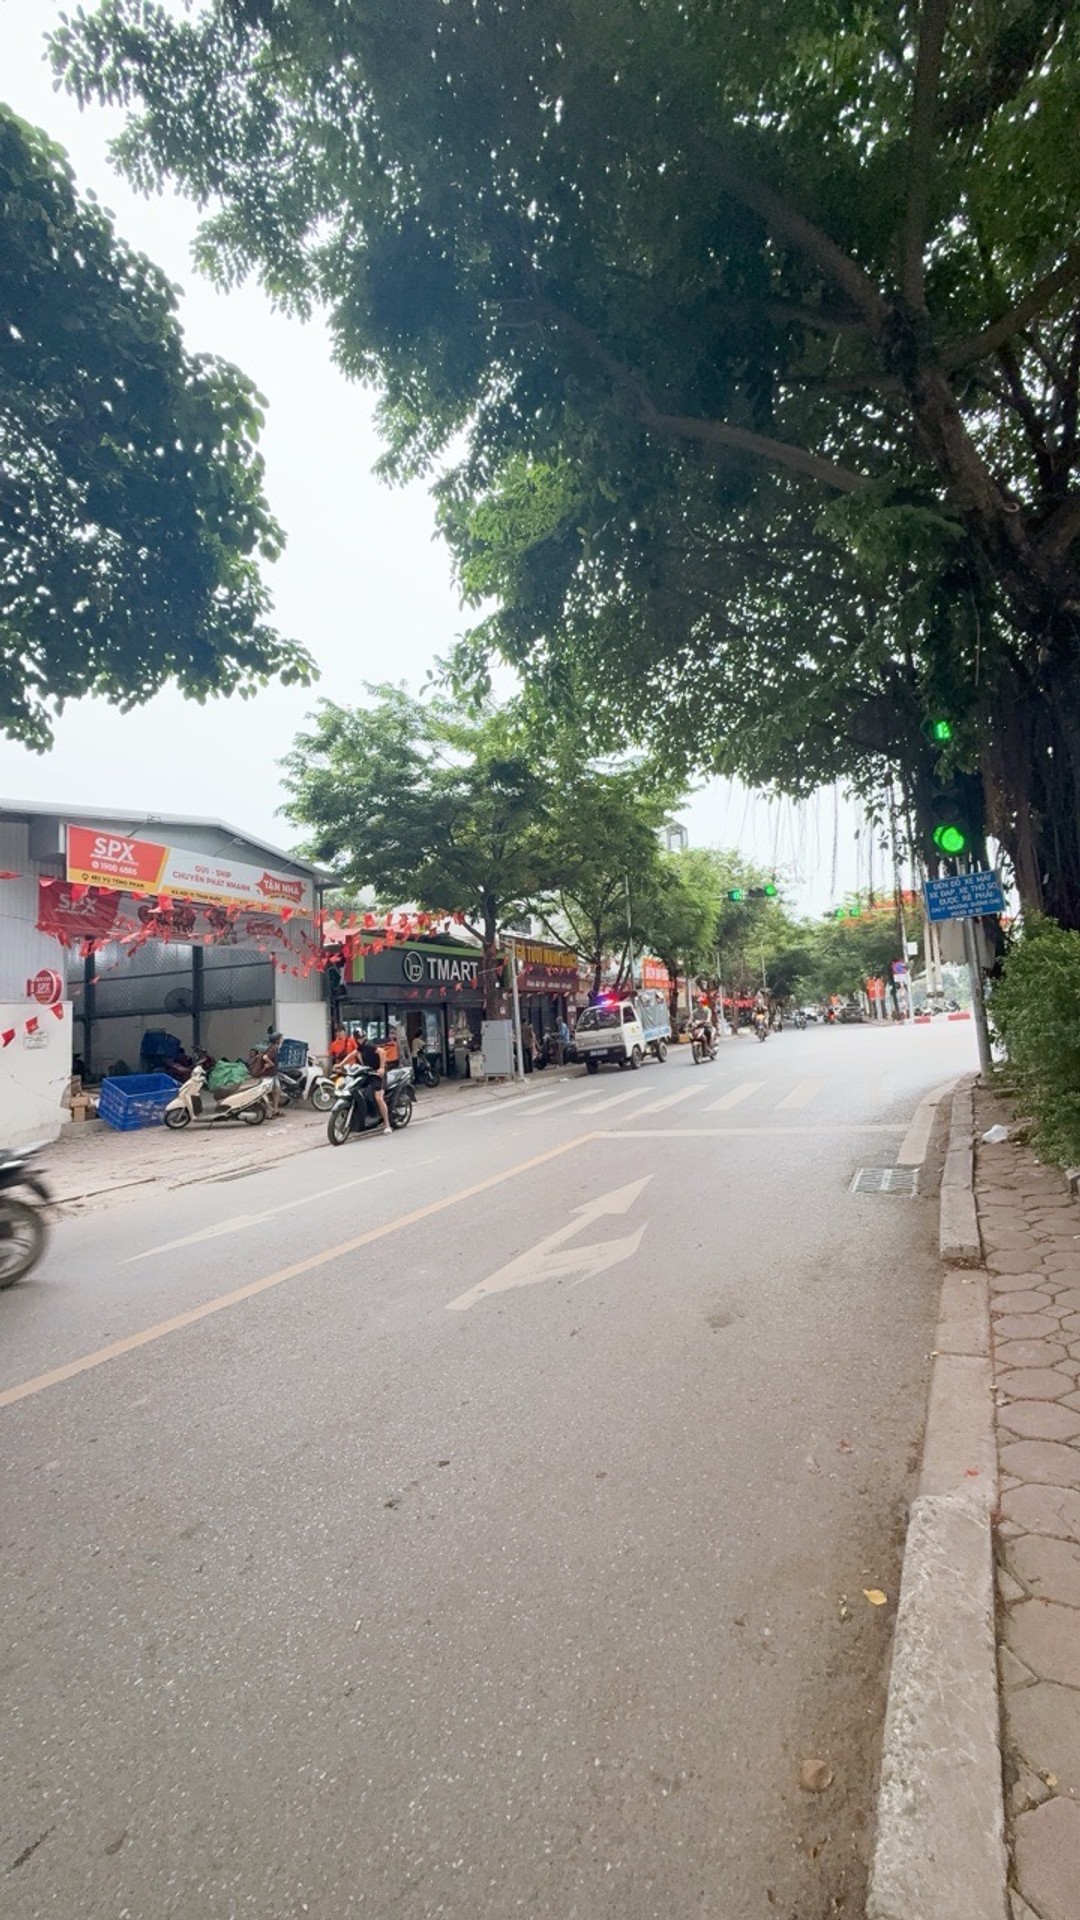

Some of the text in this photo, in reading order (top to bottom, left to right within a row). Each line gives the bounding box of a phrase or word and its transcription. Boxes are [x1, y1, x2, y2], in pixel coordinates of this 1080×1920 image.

[92, 837, 136, 862] SPX
[100, 861, 118, 873] 1900
[976, 873, 992, 882] MÁY
[226, 881, 250, 892] NHANH
[282, 884, 300, 899] NHÀ
[929, 891, 939, 899] XE
[959, 886, 968, 894] XE
[426, 957, 479, 982] TMART
[37, 982, 52, 993] SPX
